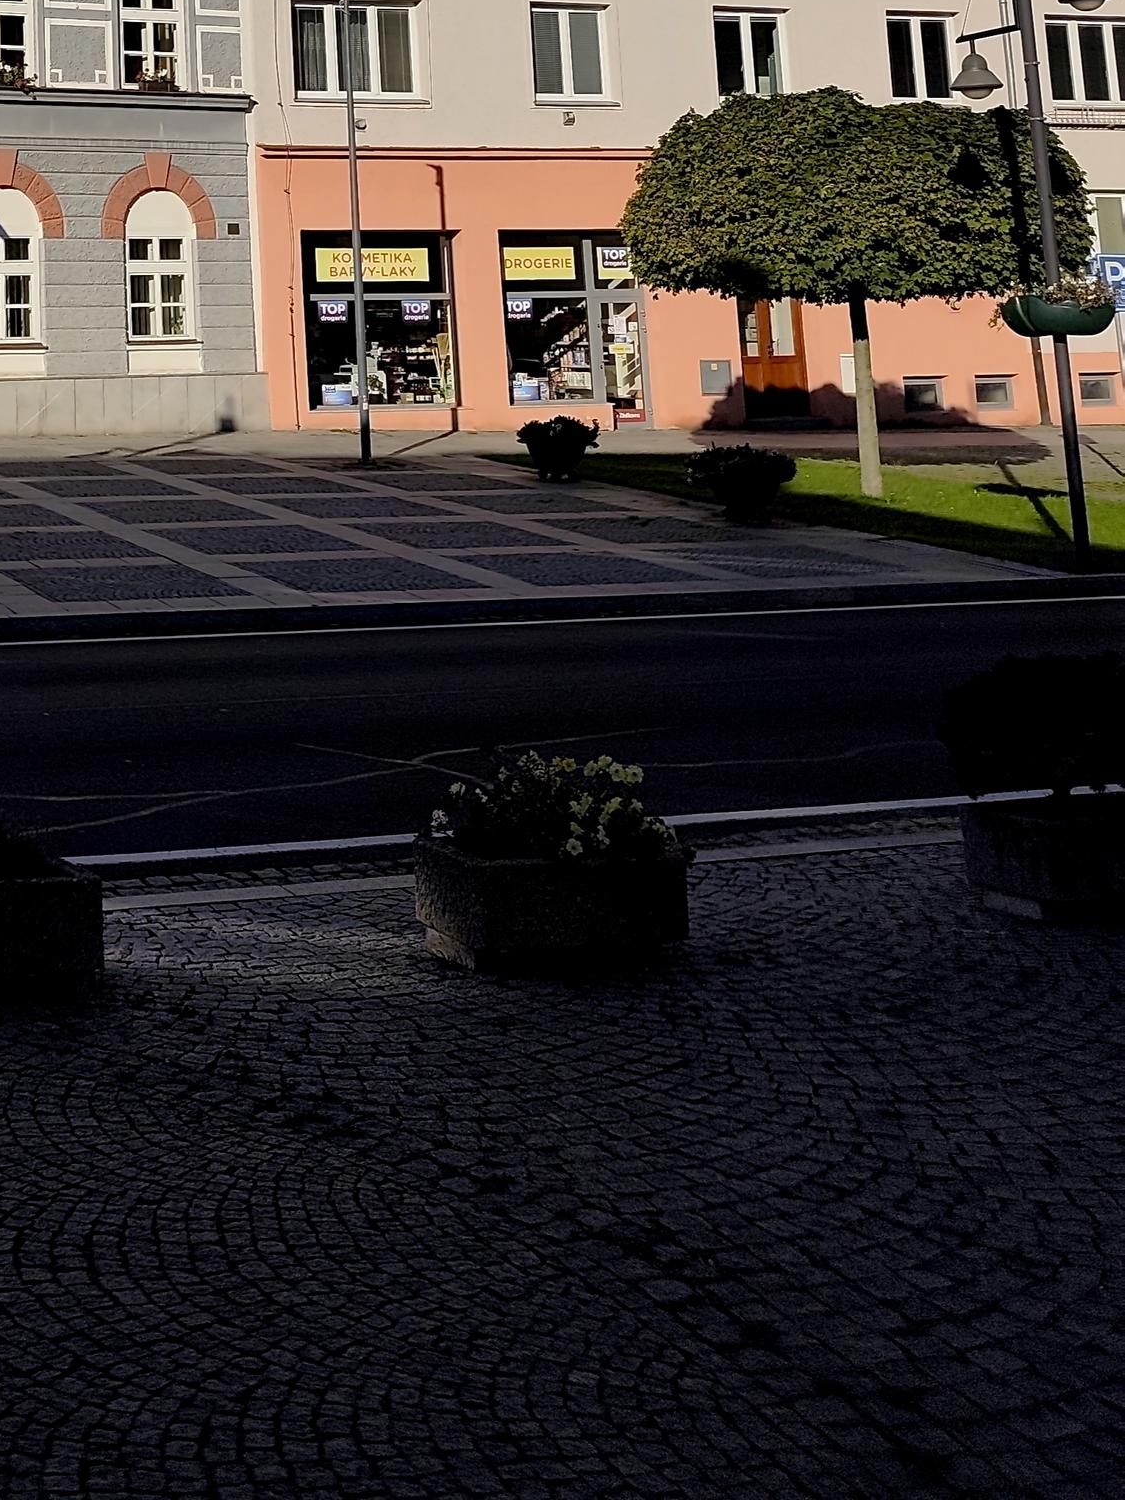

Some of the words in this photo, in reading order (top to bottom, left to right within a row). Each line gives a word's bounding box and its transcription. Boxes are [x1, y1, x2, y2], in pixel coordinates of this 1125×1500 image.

[332, 252, 413, 263] KOMETIKA
[603, 249, 626, 260] TOP
[505, 258, 572, 269] DROGERIE
[320, 303, 346, 315] TOP
[403, 303, 429, 314] TOP
[507, 301, 531, 312] TOP
